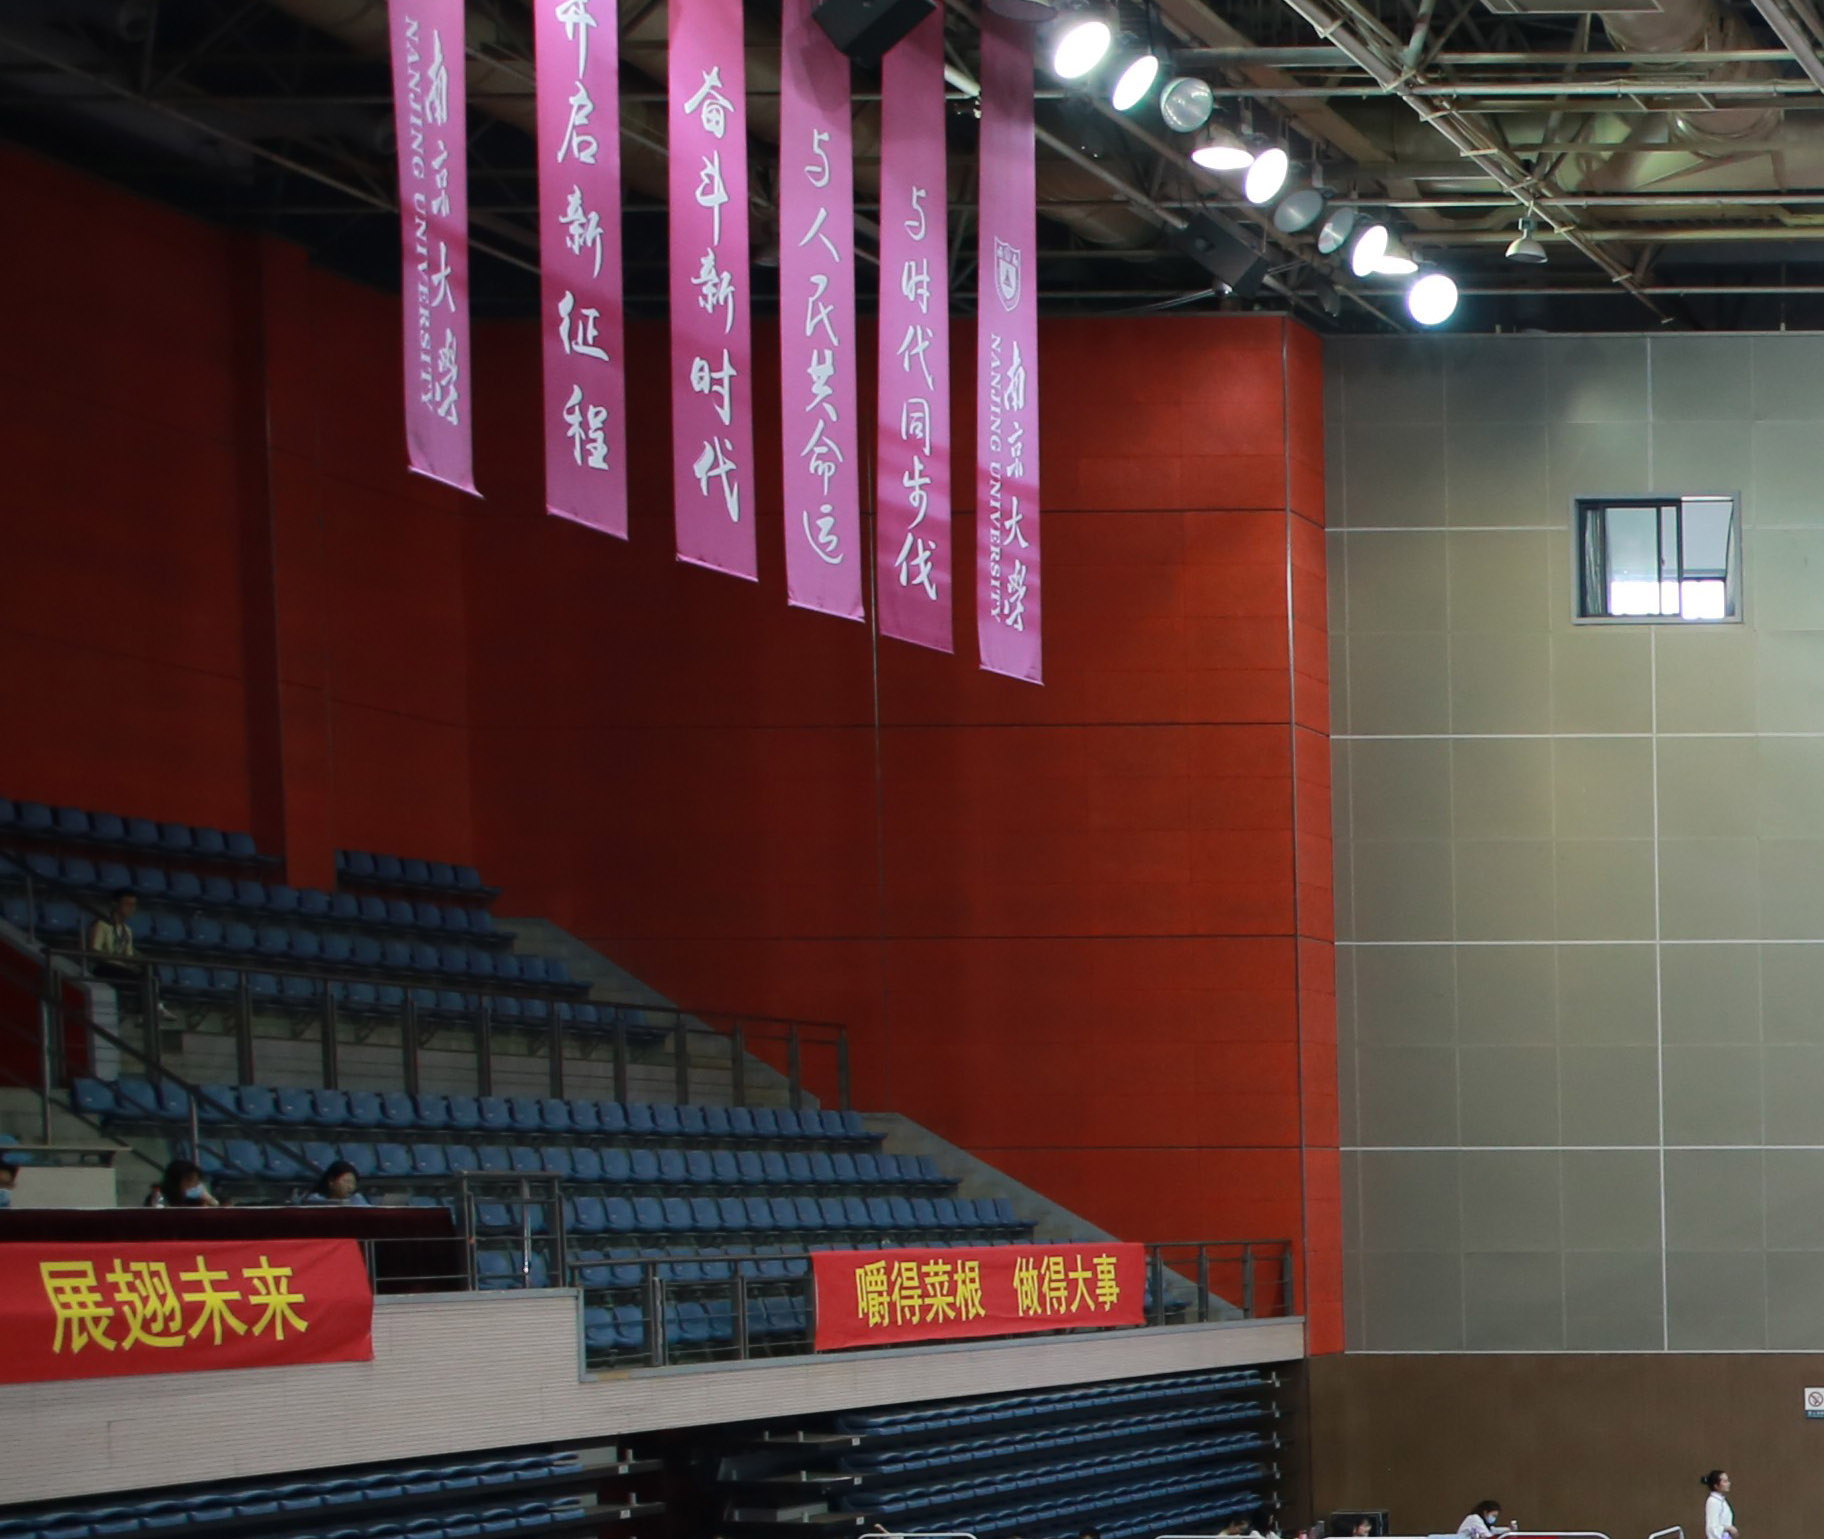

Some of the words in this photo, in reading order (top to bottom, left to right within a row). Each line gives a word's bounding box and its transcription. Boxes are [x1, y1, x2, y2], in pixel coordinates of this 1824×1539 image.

[404, 15, 425, 177] NANJING
[413, 184, 434, 412] UNIVERSITY
[684, 66, 740, 523] 奋斗新时代
[799, 128, 846, 567] 与人民共命运
[895, 186, 939, 602] 与时代同步伐
[989, 332, 1002, 456] NANJING
[989, 461, 1002, 622] UNIVERSITY
[39, 1258, 309, 1355] 展翅未来
[853, 1260, 987, 1327] 嚼得菜根
[1012, 1254, 1121, 1317] 做得大事
